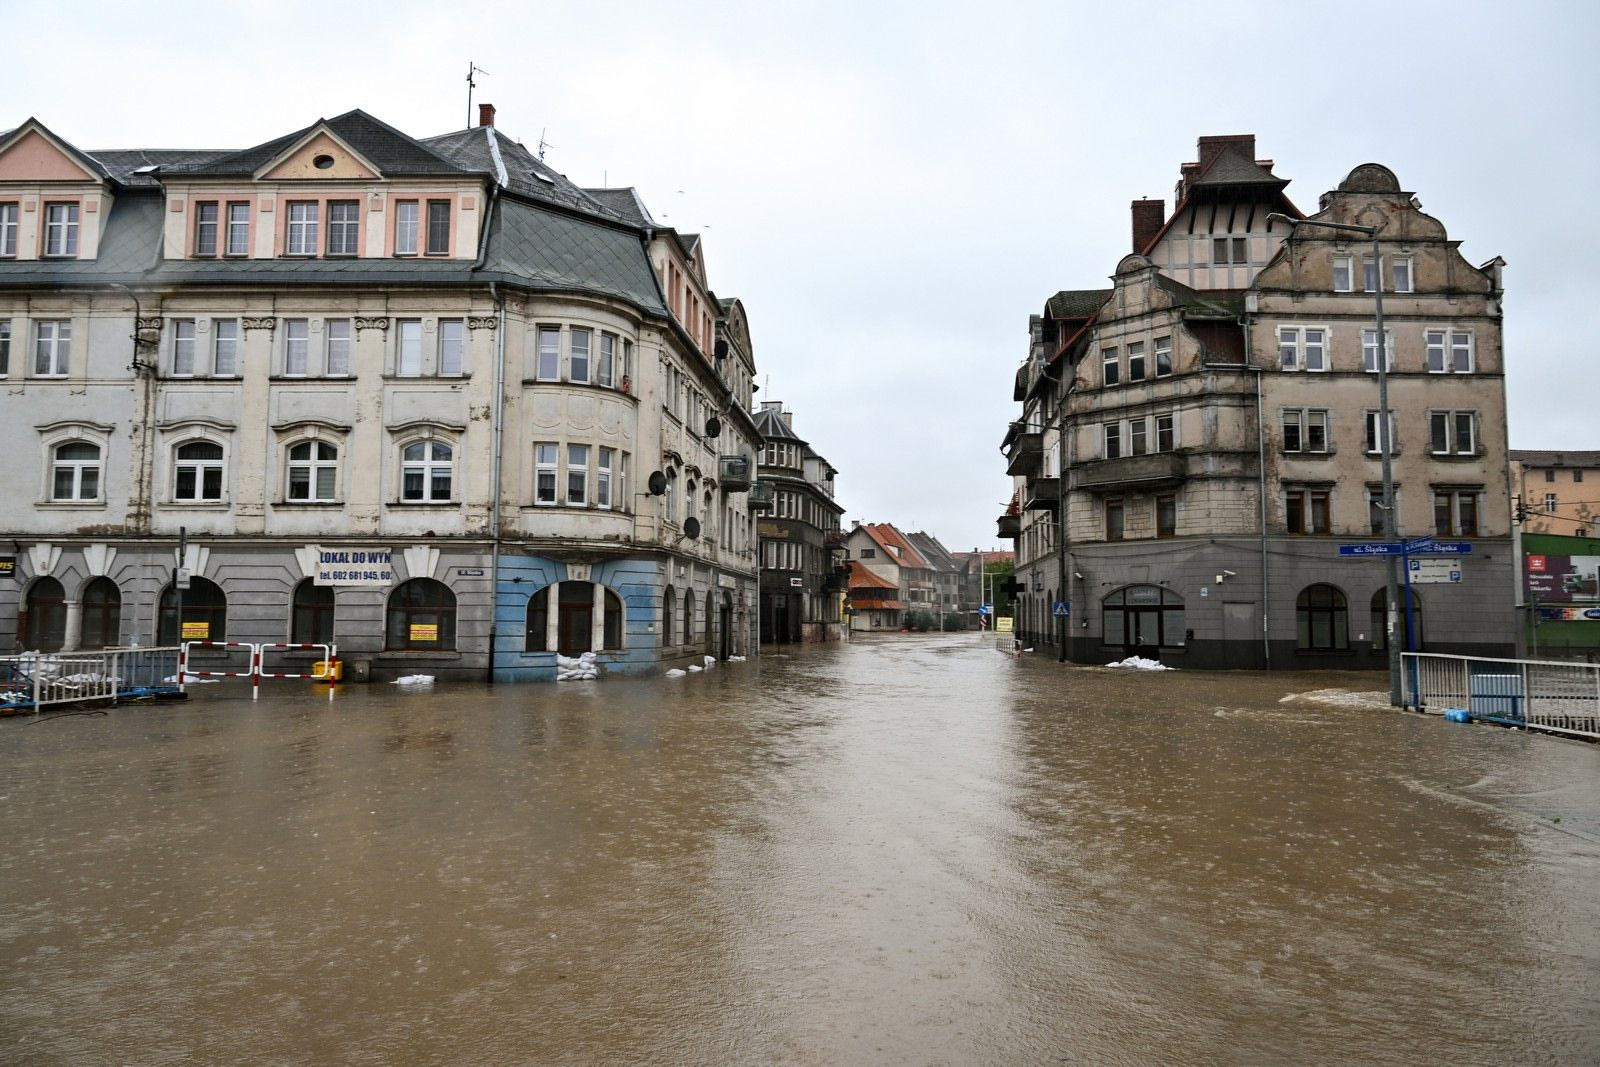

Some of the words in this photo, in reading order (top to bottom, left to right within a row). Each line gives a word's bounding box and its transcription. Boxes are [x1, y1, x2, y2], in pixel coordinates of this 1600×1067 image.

[1364, 545, 1388, 554] Śląska
[320, 552, 349, 564] LOKAL
[352, 552, 366, 564] DO
[320, 571, 331, 580] tel.
[333, 571, 347, 580] 602
[348, 571, 362, 580] 681
